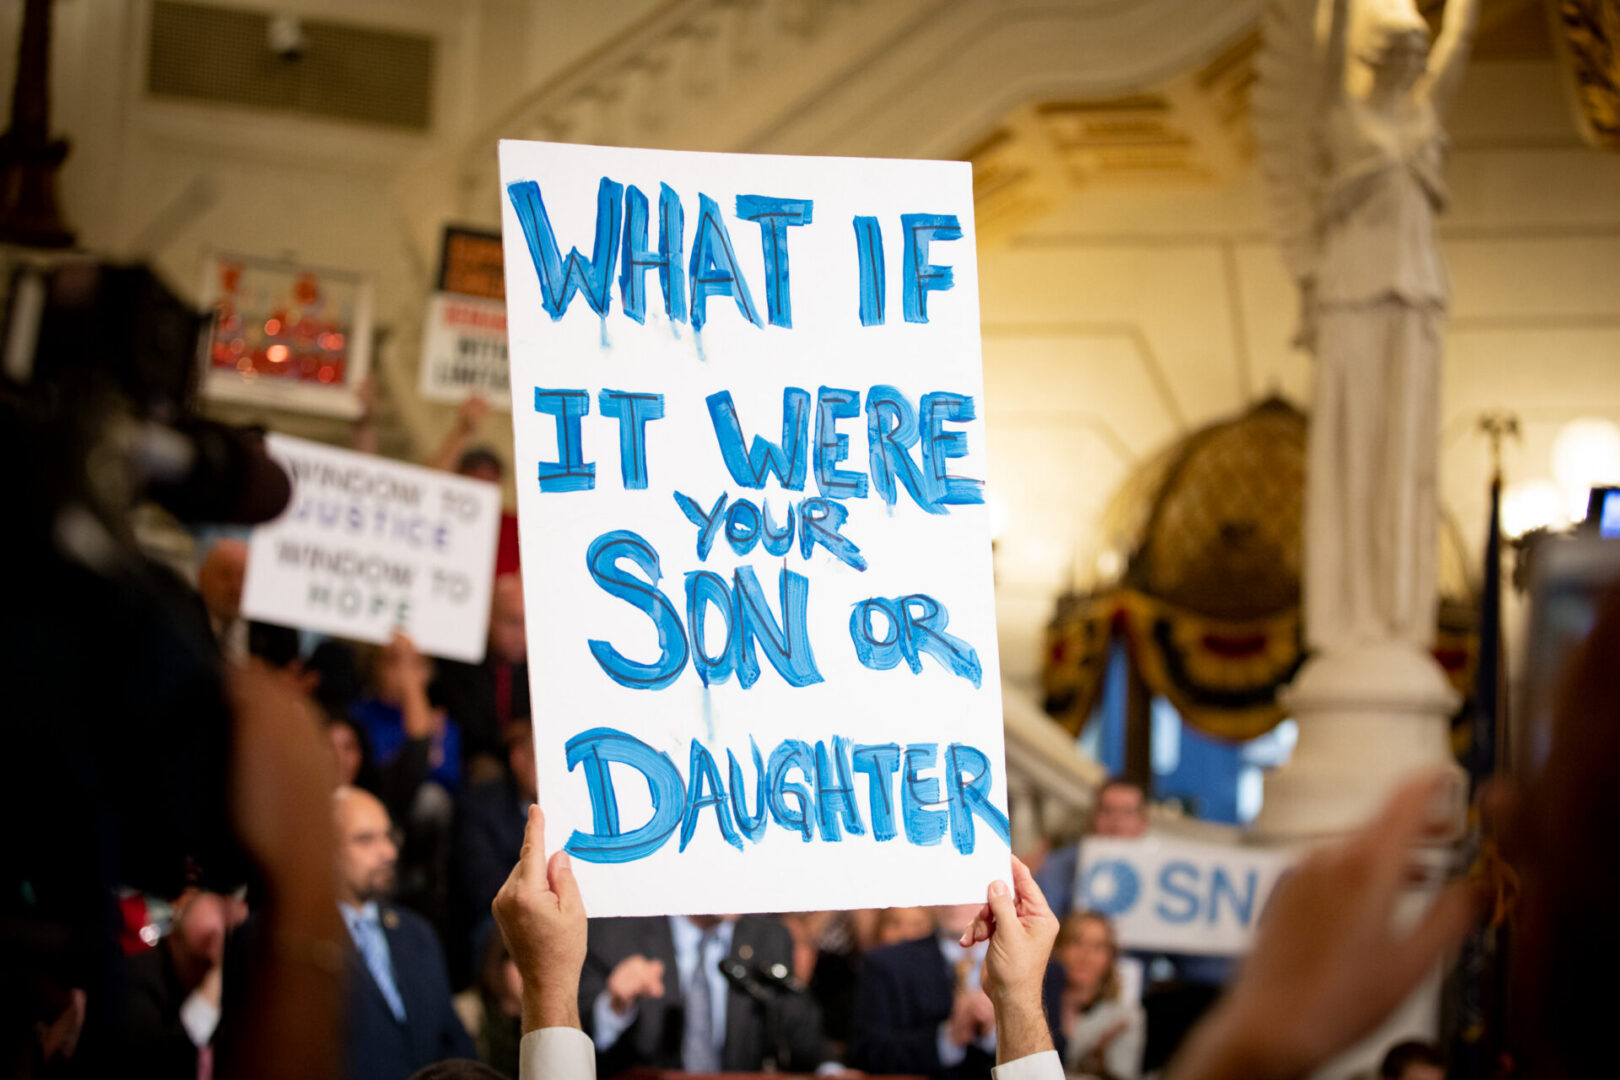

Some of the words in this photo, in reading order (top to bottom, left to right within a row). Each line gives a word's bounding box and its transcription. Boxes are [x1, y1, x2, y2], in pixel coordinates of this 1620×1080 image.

[507, 177, 813, 334] WHAT
[853, 213, 964, 327] IF
[534, 386, 665, 493] IT
[706, 385, 986, 514] WERE
[290, 456, 422, 507] WINDOW
[440, 488, 482, 524] TO
[298, 498, 450, 551] JUSTICE
[673, 490, 868, 572] YOUR
[276, 541, 415, 588] WINDOW
[431, 567, 474, 605] TO
[308, 583, 413, 622] HOPE
[586, 530, 825, 690] SON
[850, 594, 982, 689] OR
[563, 727, 1011, 864] DAUGHTER
[1155, 860, 1264, 930] SN
